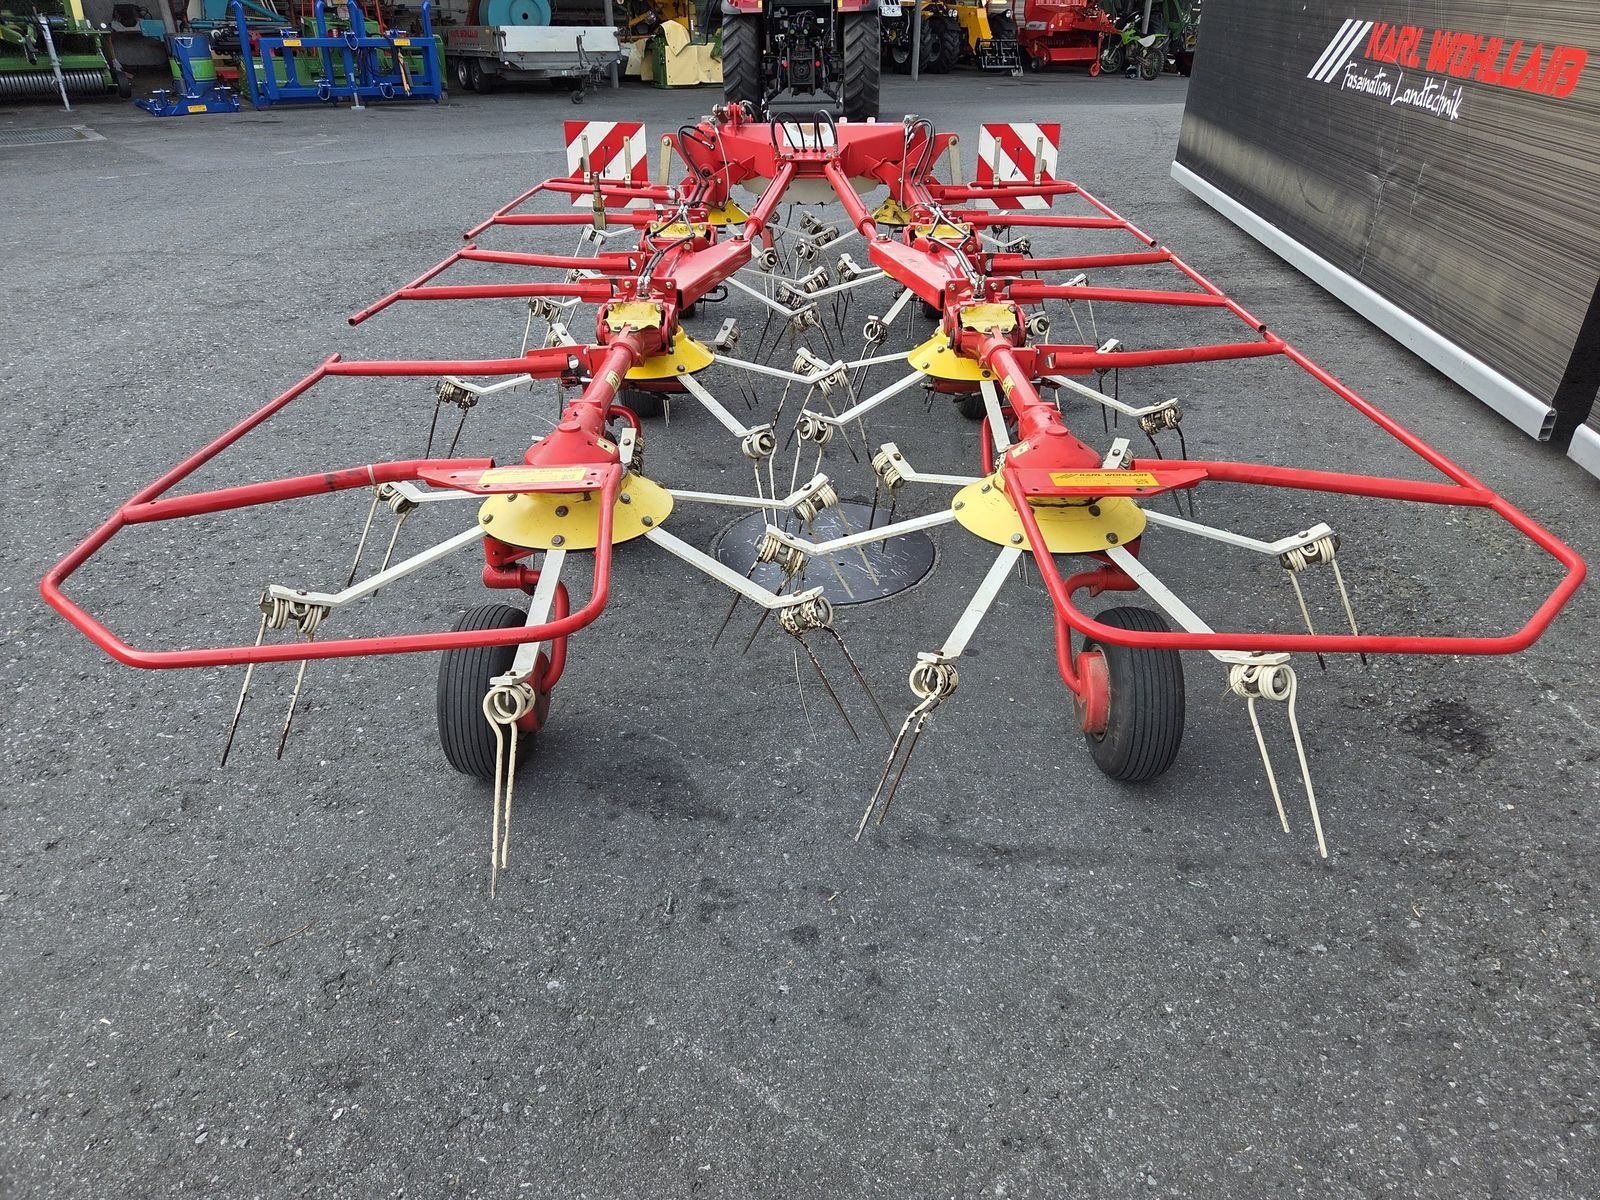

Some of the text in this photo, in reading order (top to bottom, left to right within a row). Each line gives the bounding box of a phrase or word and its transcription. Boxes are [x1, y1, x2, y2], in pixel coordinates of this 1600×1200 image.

[1365, 22, 1424, 69] KARL
[1340, 60, 1464, 120] Faszination Landtechnik
